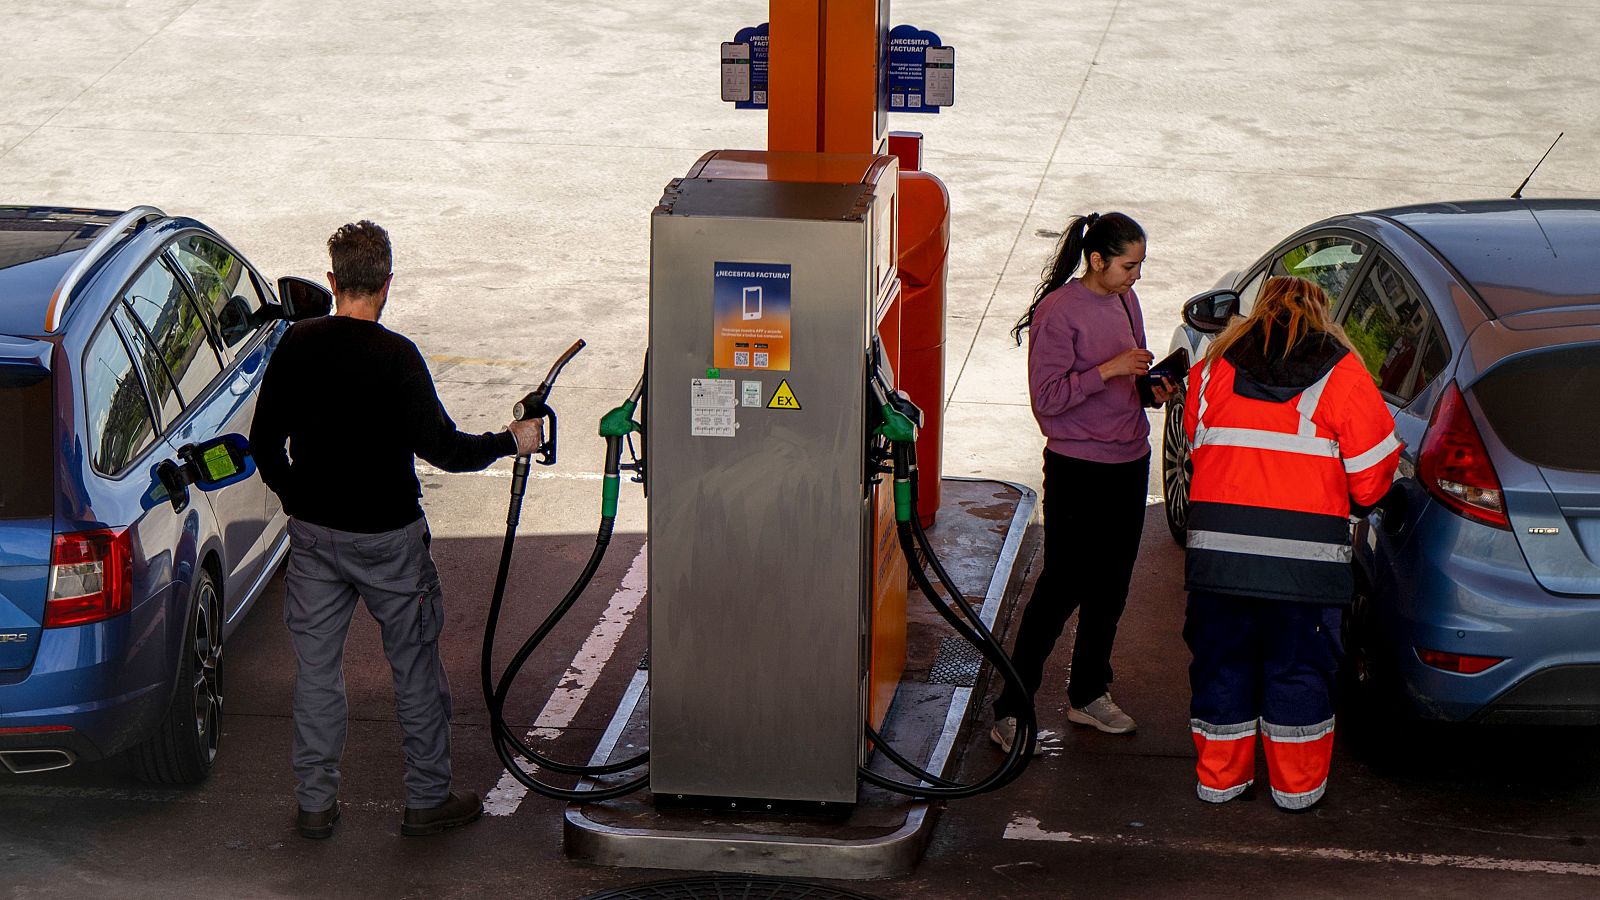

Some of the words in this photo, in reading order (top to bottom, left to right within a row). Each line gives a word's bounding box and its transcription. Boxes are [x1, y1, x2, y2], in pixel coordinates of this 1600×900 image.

[891, 38, 930, 46] ¿NECESITAS
[715, 269, 755, 278] ¿NECESITAS
[756, 271, 790, 279] FACTURA?
[777, 396, 792, 406] EX
